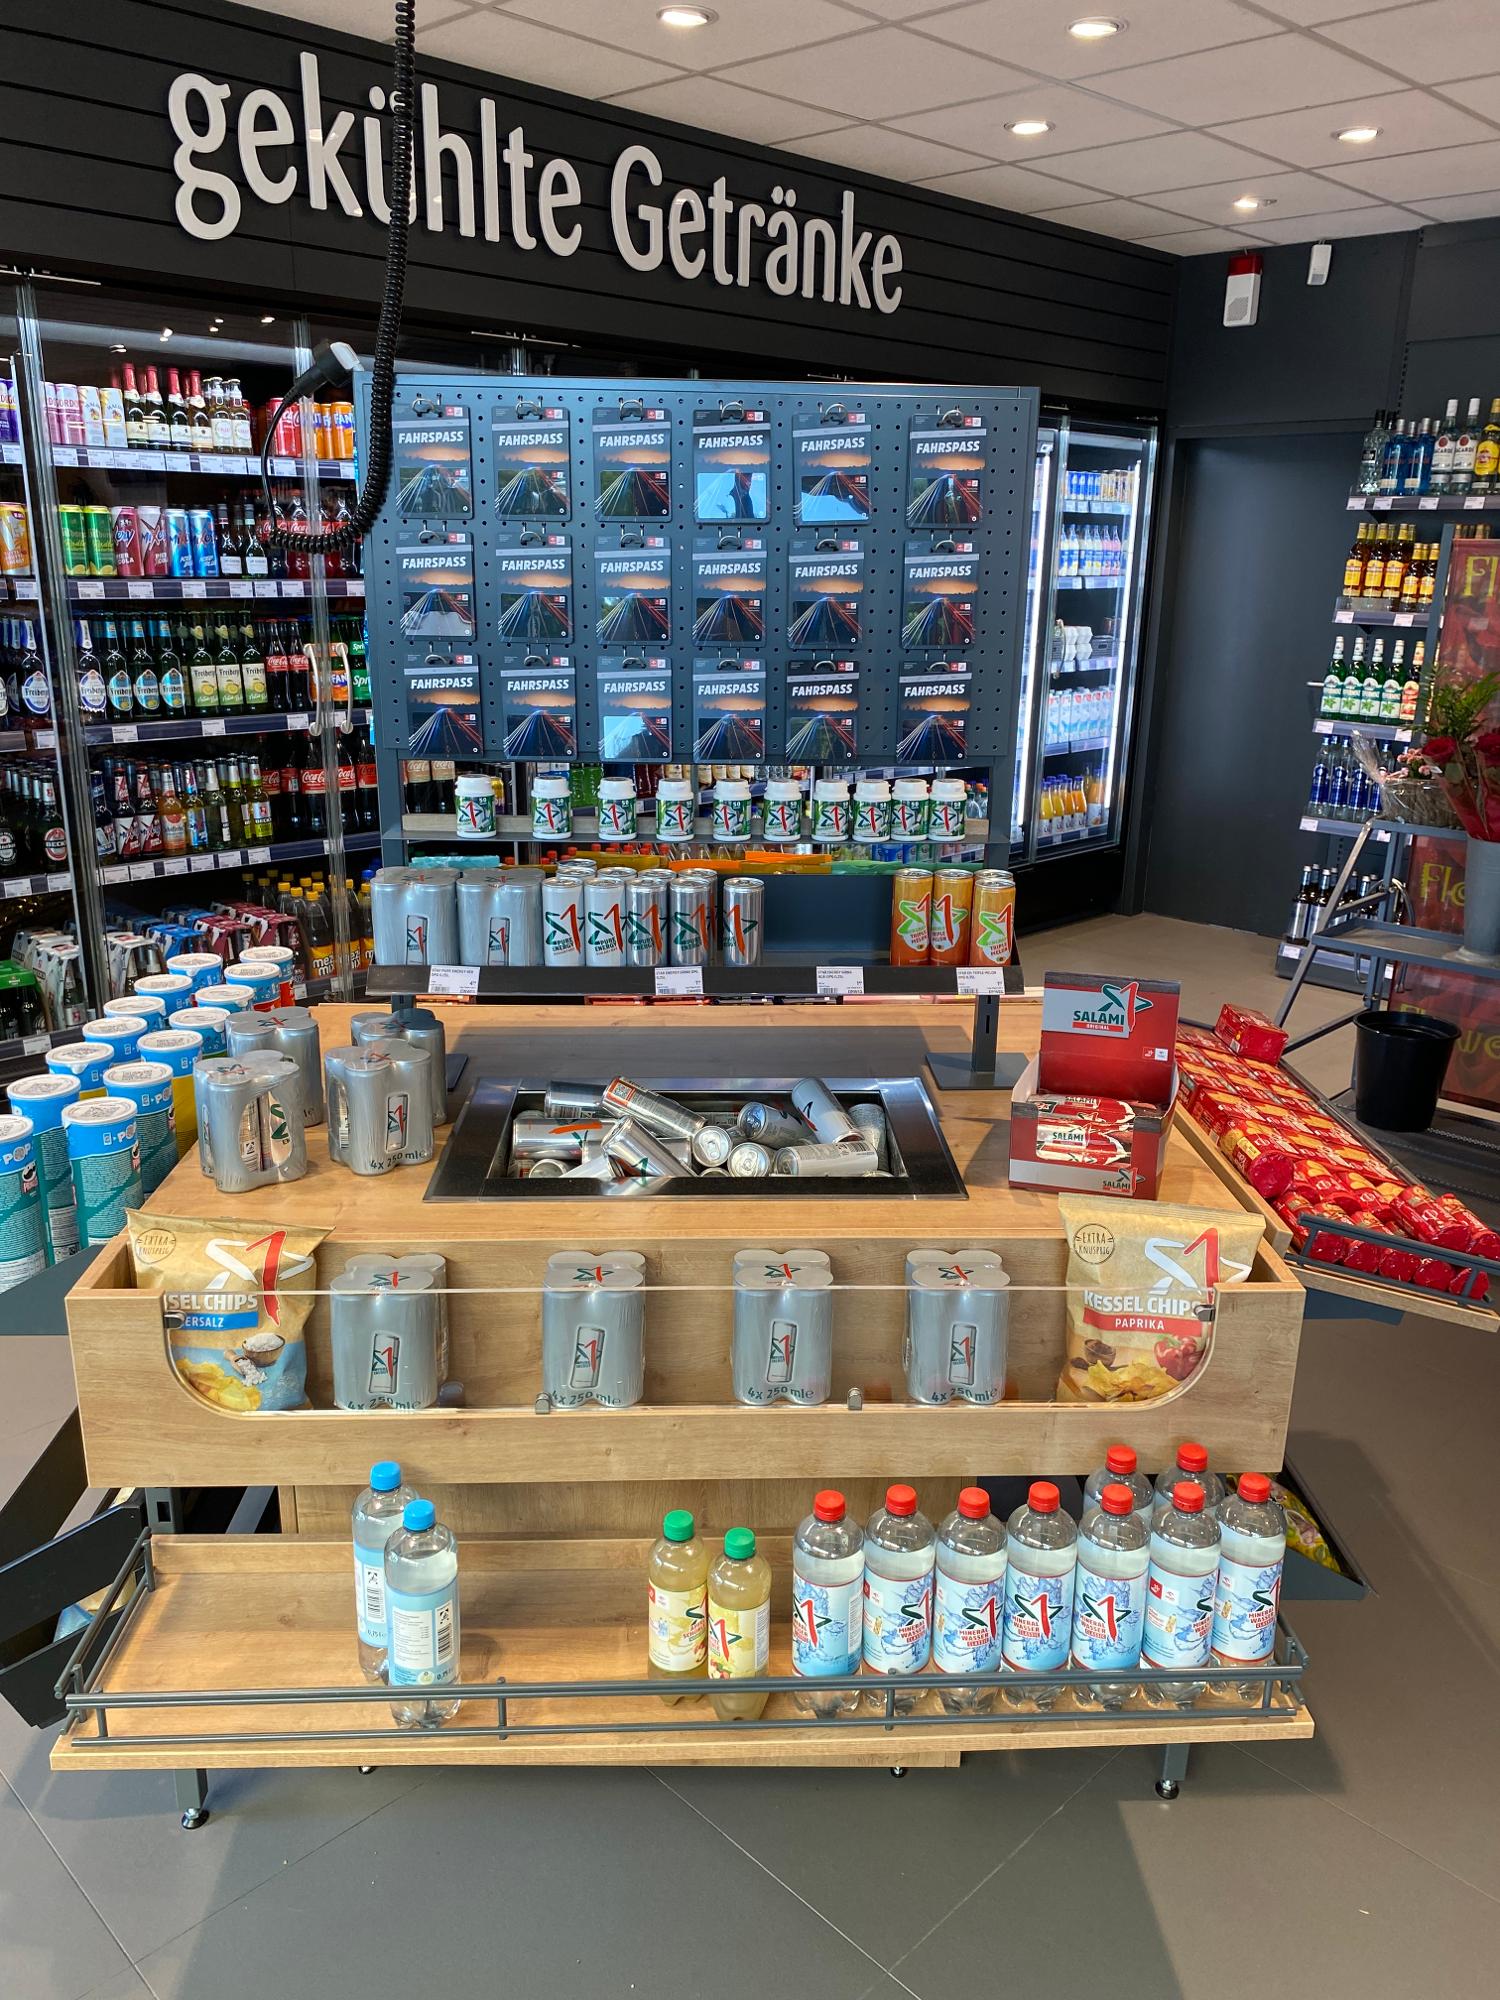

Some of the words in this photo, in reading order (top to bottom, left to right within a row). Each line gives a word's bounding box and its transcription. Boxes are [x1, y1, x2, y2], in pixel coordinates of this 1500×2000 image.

[168, 52, 582, 257] gekühlte
[611, 145, 903, 314] Getränke
[399, 431, 463, 444] FAHRSPASS
[499, 433, 563, 446] FAHRSPASS
[600, 434, 664, 447] FAHRSPASS
[699, 434, 763, 448] FAHRSPASS
[801, 437, 865, 452] FAHRSPASS
[916, 441, 980, 454] FAHRSPASS
[403, 557, 466, 569] FAHRSPASS
[502, 559, 565, 571] FAHRSPASS
[601, 561, 664, 573] FAHRSPASS
[699, 562, 761, 575] FAHRSPASS
[795, 564, 858, 578] FAHRSPASS
[909, 565, 972, 579] FAHRSPASS
[411, 678, 473, 689] FAHRSPASS
[507, 679, 569, 691] FAHRSPASS
[604, 681, 666, 693] FAHRSPASS
[698, 683, 760, 695] FAHRSPASS
[792, 684, 853, 697] FAHRSPASS
[904, 684, 965, 697] FAHRSPASS
[1073, 1010, 1125, 1025] SALAMI
[1052, 1132, 1084, 1142] SALAMI
[1102, 1180, 1130, 1190] SALAMI
[1082, 1232, 1106, 1244] EXTRA
[204, 1294, 258, 1310] CHIPS
[1084, 1290, 1144, 1313] KESSEL
[185, 1316, 224, 1328] ERSALZ
[1115, 1318, 1164, 1330] PAPRIKA
[960, 1628, 989, 1636] MINERAL
[1014, 1622, 1040, 1632] WASSER
[962, 1632, 989, 1640] WASSER
